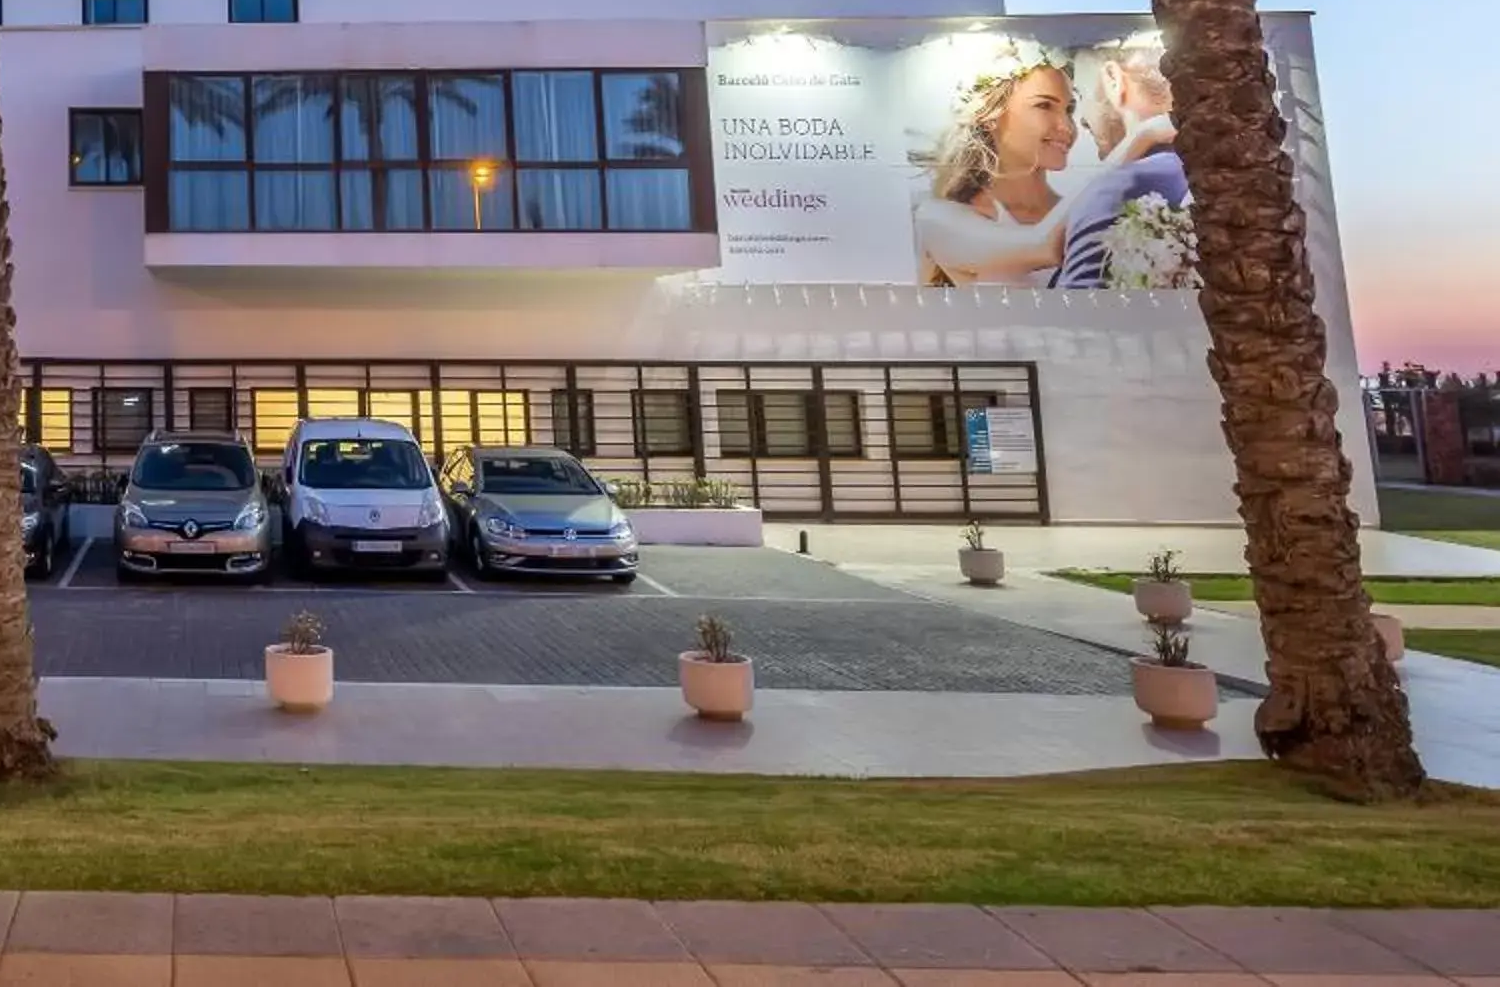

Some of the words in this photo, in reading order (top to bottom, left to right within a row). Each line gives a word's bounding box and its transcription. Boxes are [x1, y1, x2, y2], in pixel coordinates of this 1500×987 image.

[721, 118, 772, 136] UNA
[777, 118, 845, 136] BODA
[723, 141, 877, 161] INOLVIDABLE
[723, 189, 828, 212] weddings
